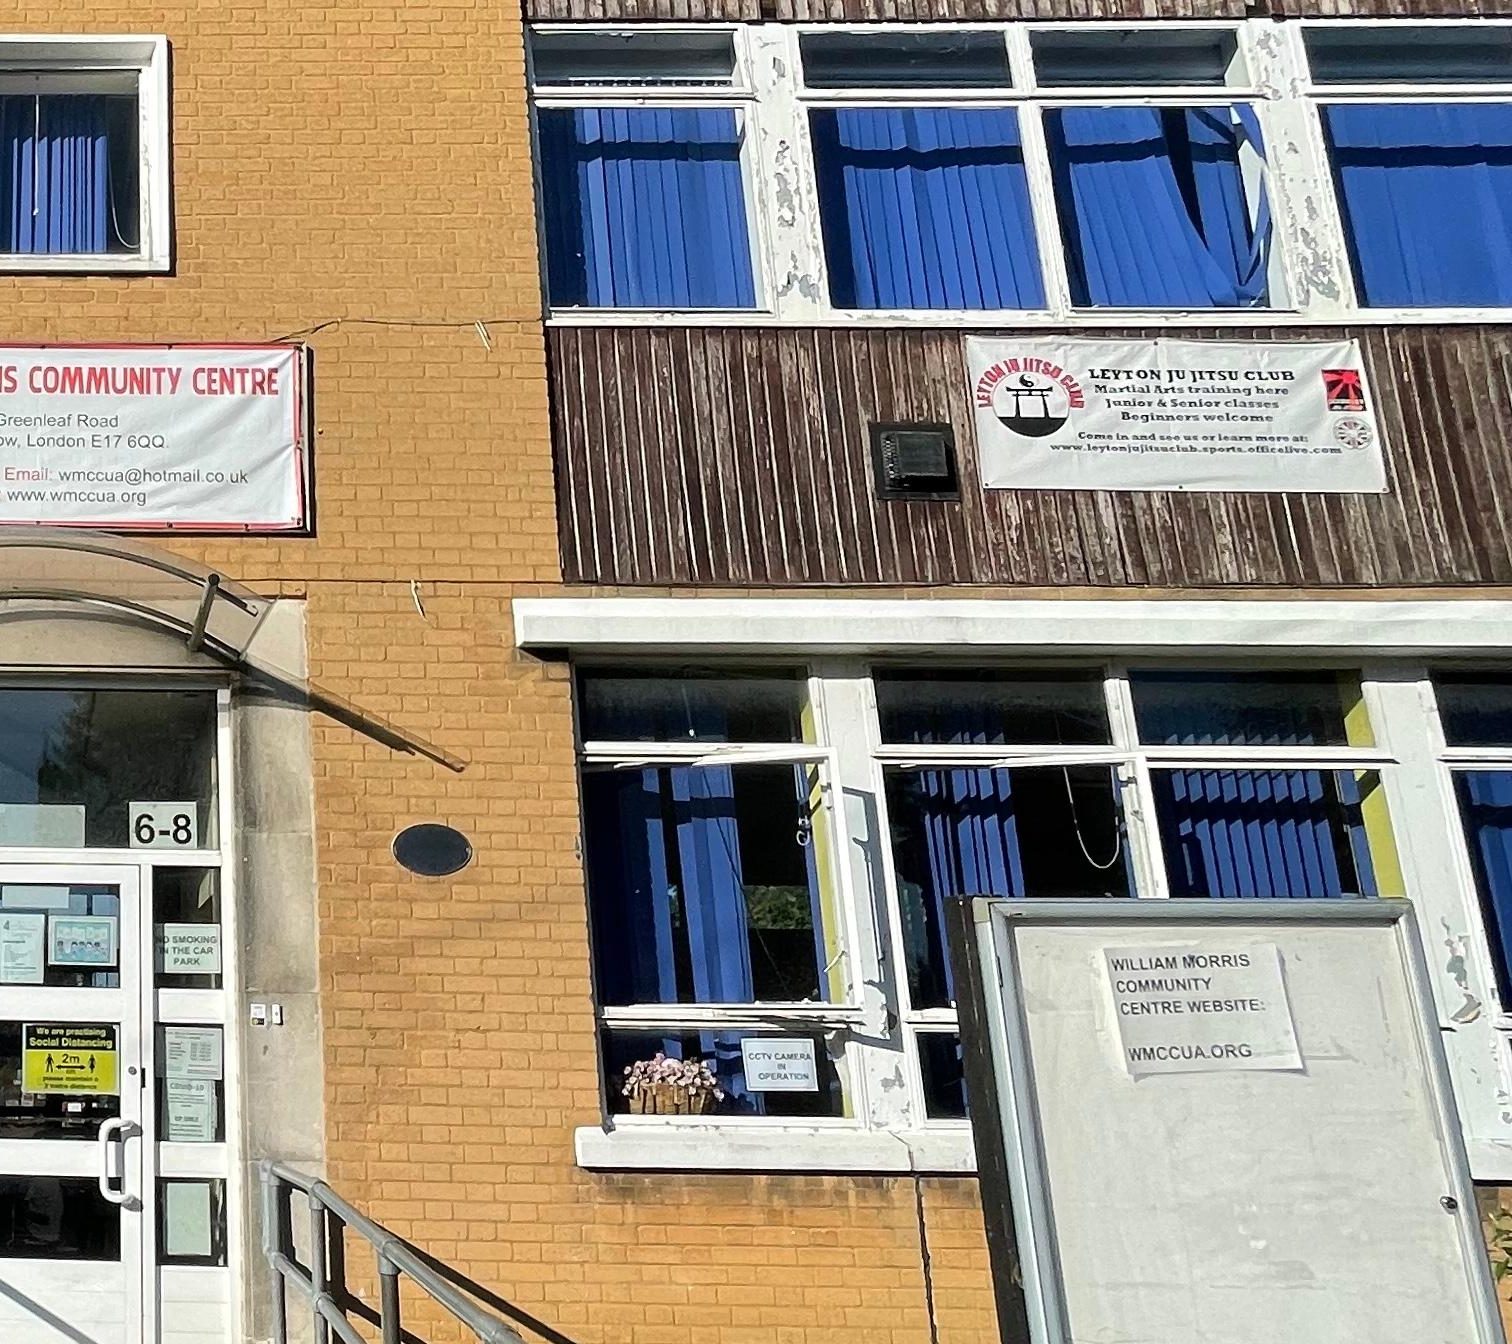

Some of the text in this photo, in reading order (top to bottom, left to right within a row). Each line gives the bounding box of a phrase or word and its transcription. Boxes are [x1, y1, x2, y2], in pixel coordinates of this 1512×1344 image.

[29, 366, 182, 395] COMMUNITY
[192, 367, 279, 395] CENTRE
[1088, 368, 1296, 383] LEYTON JU JITSU CLUB
[1094, 384, 1289, 396] Martial Arts training here
[1105, 398, 1279, 409] Junior & Senior classes
[77, 414, 119, 428] Road
[1121, 411, 1274, 423] Beginners welcome
[27, 433, 85, 448] London
[91, 435, 123, 449] E17
[1078, 431, 1113, 441] Come
[1116, 432, 1129, 441] in
[1132, 432, 1156, 441] and
[1159, 434, 1180, 442] see
[1183, 434, 1199, 442] us
[1201, 434, 1216, 442] or
[1218, 432, 1252, 442] learn
[1255, 435, 1289, 443] more
[4, 466, 52, 482] Email:
[59, 468, 249, 486] wmccua@hotmail.co.uk
[6, 490, 146, 506] www.wmccua.org
[134, 813, 192, 845] 6-8
[172, 935, 217, 944] SMOKING
[172, 946, 190, 955] THE
[193, 946, 213, 955] CAR
[173, 957, 200, 966] PARK
[1111, 954, 1250, 972] WILLIAM MORRIS
[1116, 977, 1212, 994] COMMUNITY
[1120, 998, 1266, 1016] CENTRE WEBSITE:
[36, 1027, 49, 1035] We
[66, 1027, 106, 1037] practising
[29, 1037, 113, 1049] Social Distancing
[62, 1053, 80, 1064] 2m
[748, 1052, 812, 1061] CCTV CAMERA
[1128, 1043, 1252, 1062] WMCCUA.ORG
[777, 1063, 786, 1071] IN
[758, 1072, 809, 1081] OPERATION
